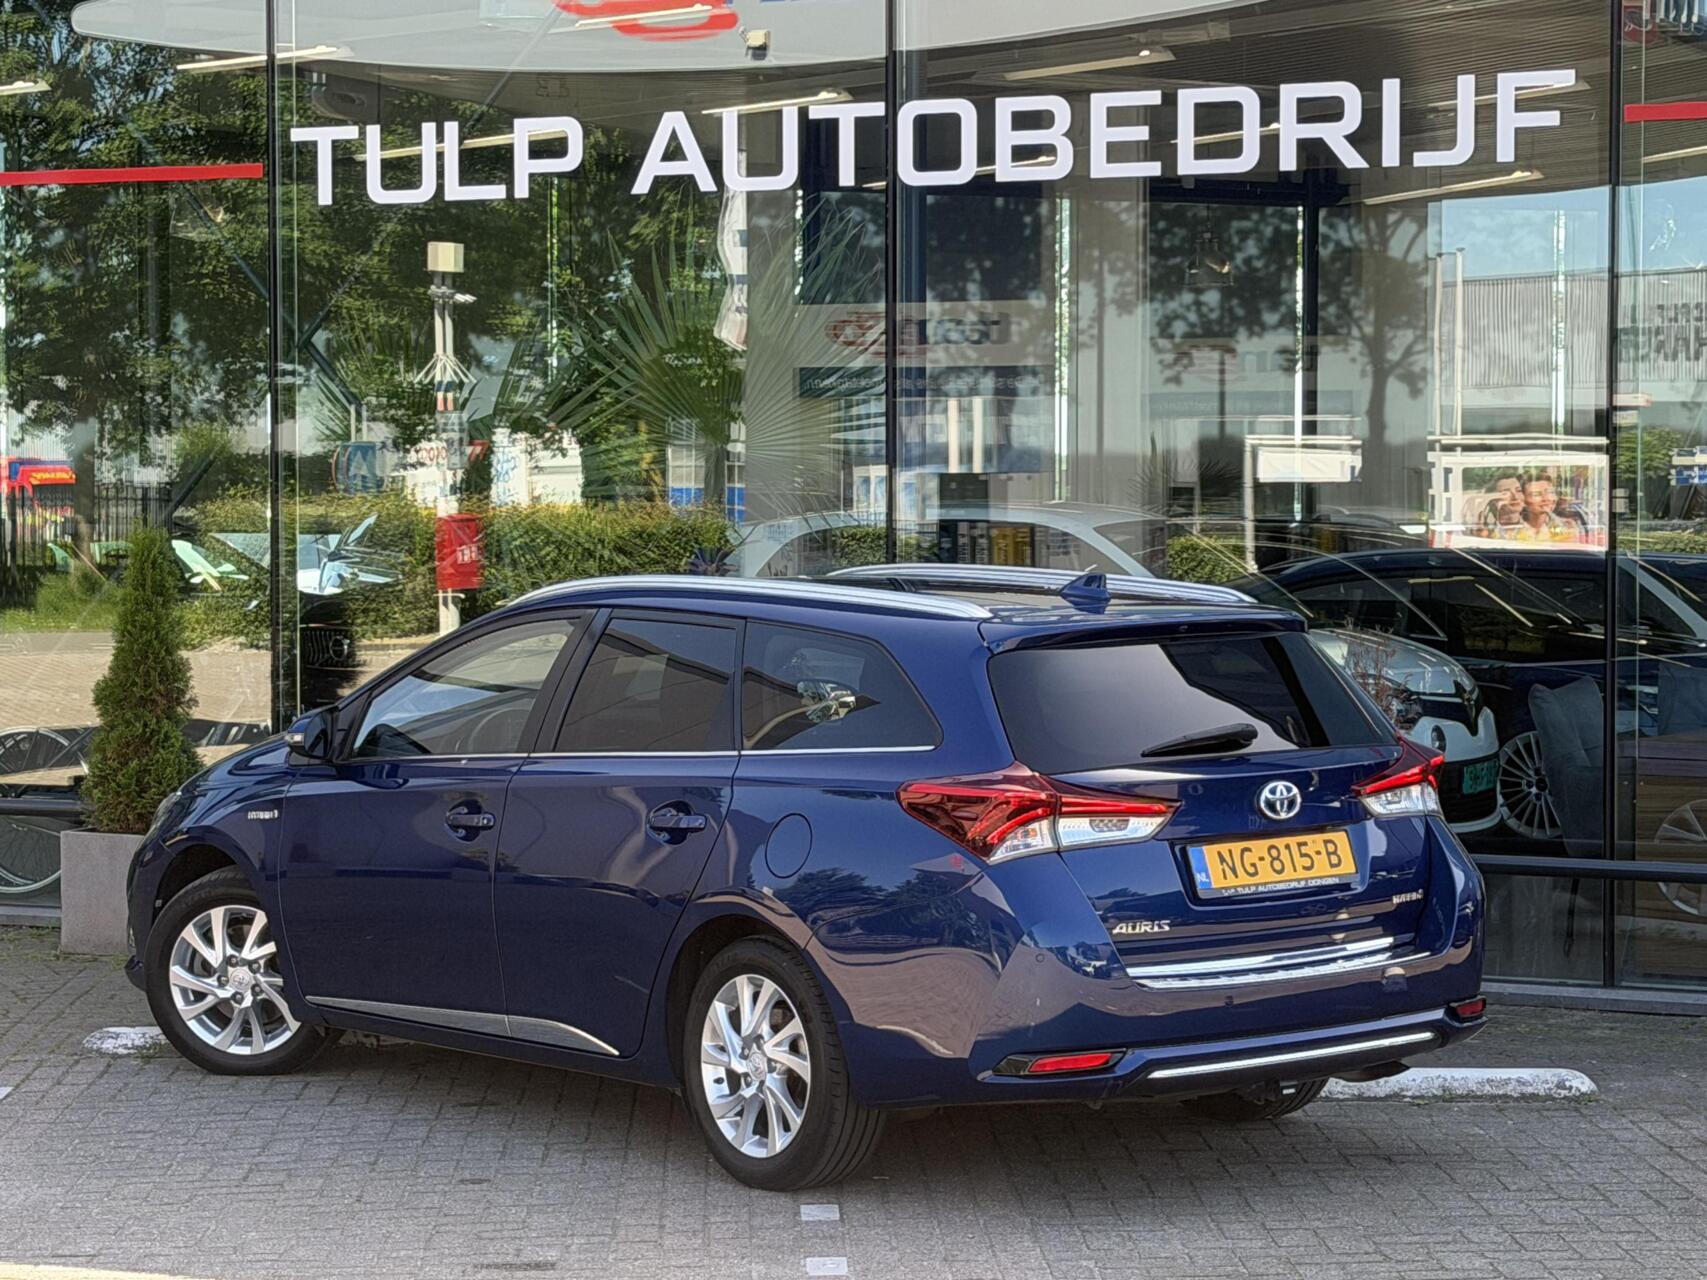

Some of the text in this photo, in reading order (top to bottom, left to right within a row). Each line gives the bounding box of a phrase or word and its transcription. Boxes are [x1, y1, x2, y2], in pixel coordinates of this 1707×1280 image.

[290, 69, 1576, 206] TULP AUTOBEDRIJF
[1217, 839, 1342, 880] NG-815-B
[1112, 919, 1171, 935] AURIS
